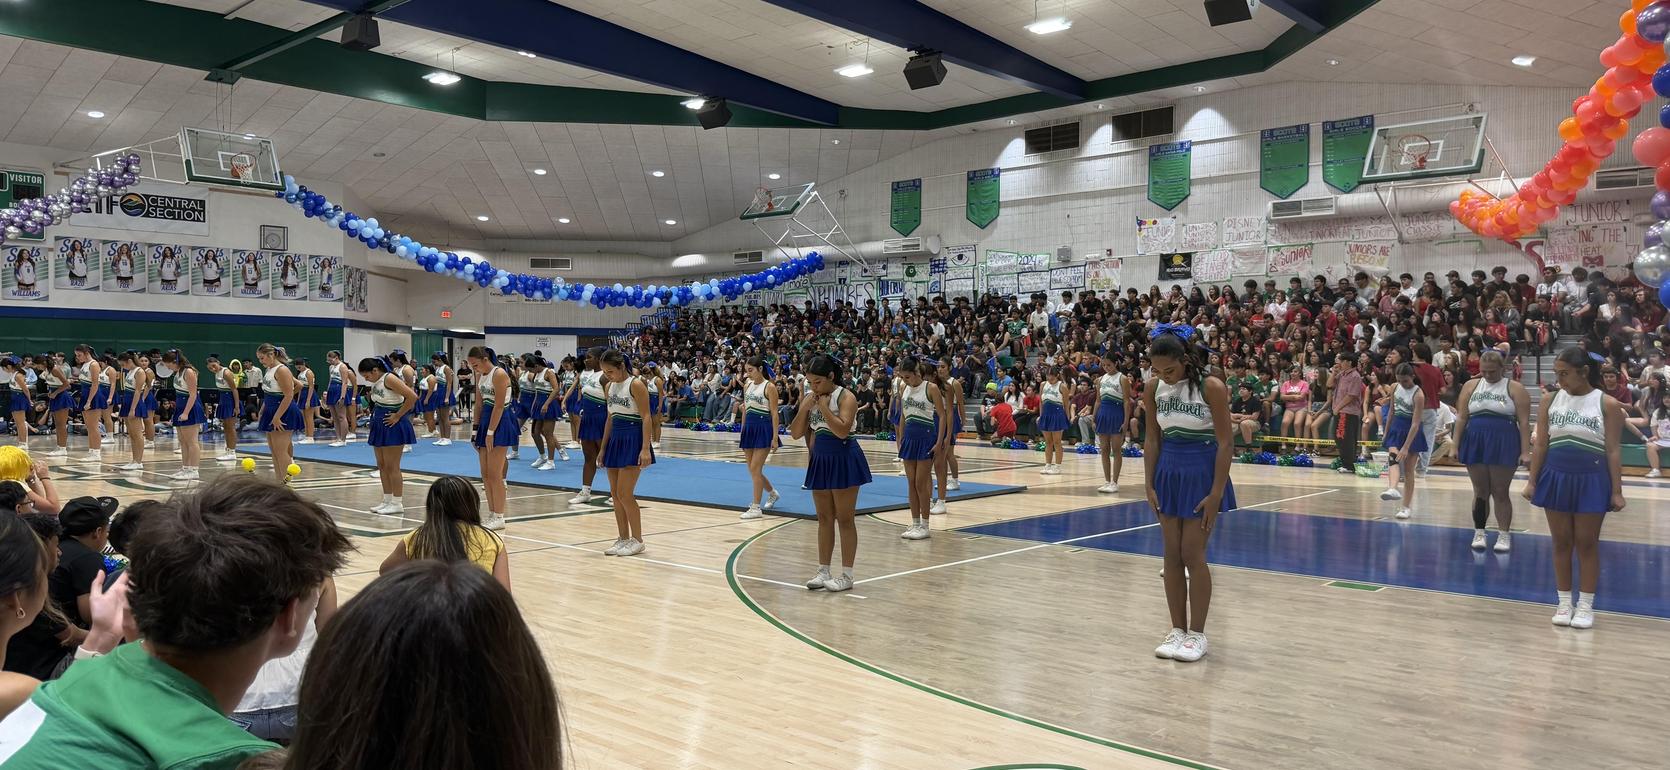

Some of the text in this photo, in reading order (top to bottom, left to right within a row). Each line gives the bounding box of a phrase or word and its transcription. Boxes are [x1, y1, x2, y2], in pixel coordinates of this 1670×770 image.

[9, 173, 42, 184] VISITOR
[148, 196, 204, 210] CENTRAL
[148, 207, 204, 221] SECTION
[1569, 200, 1626, 223] JUNIOR
[1227, 217, 1262, 229] DISNEY
[1224, 230, 1261, 241] JUNIOR
[1601, 227, 1622, 243] THE
[1347, 244, 1377, 255] JUNIORS
[1580, 245, 1602, 257] HEAT
[1018, 254, 1037, 268] 2024
[11, 289, 41, 297] WILLIAMS
